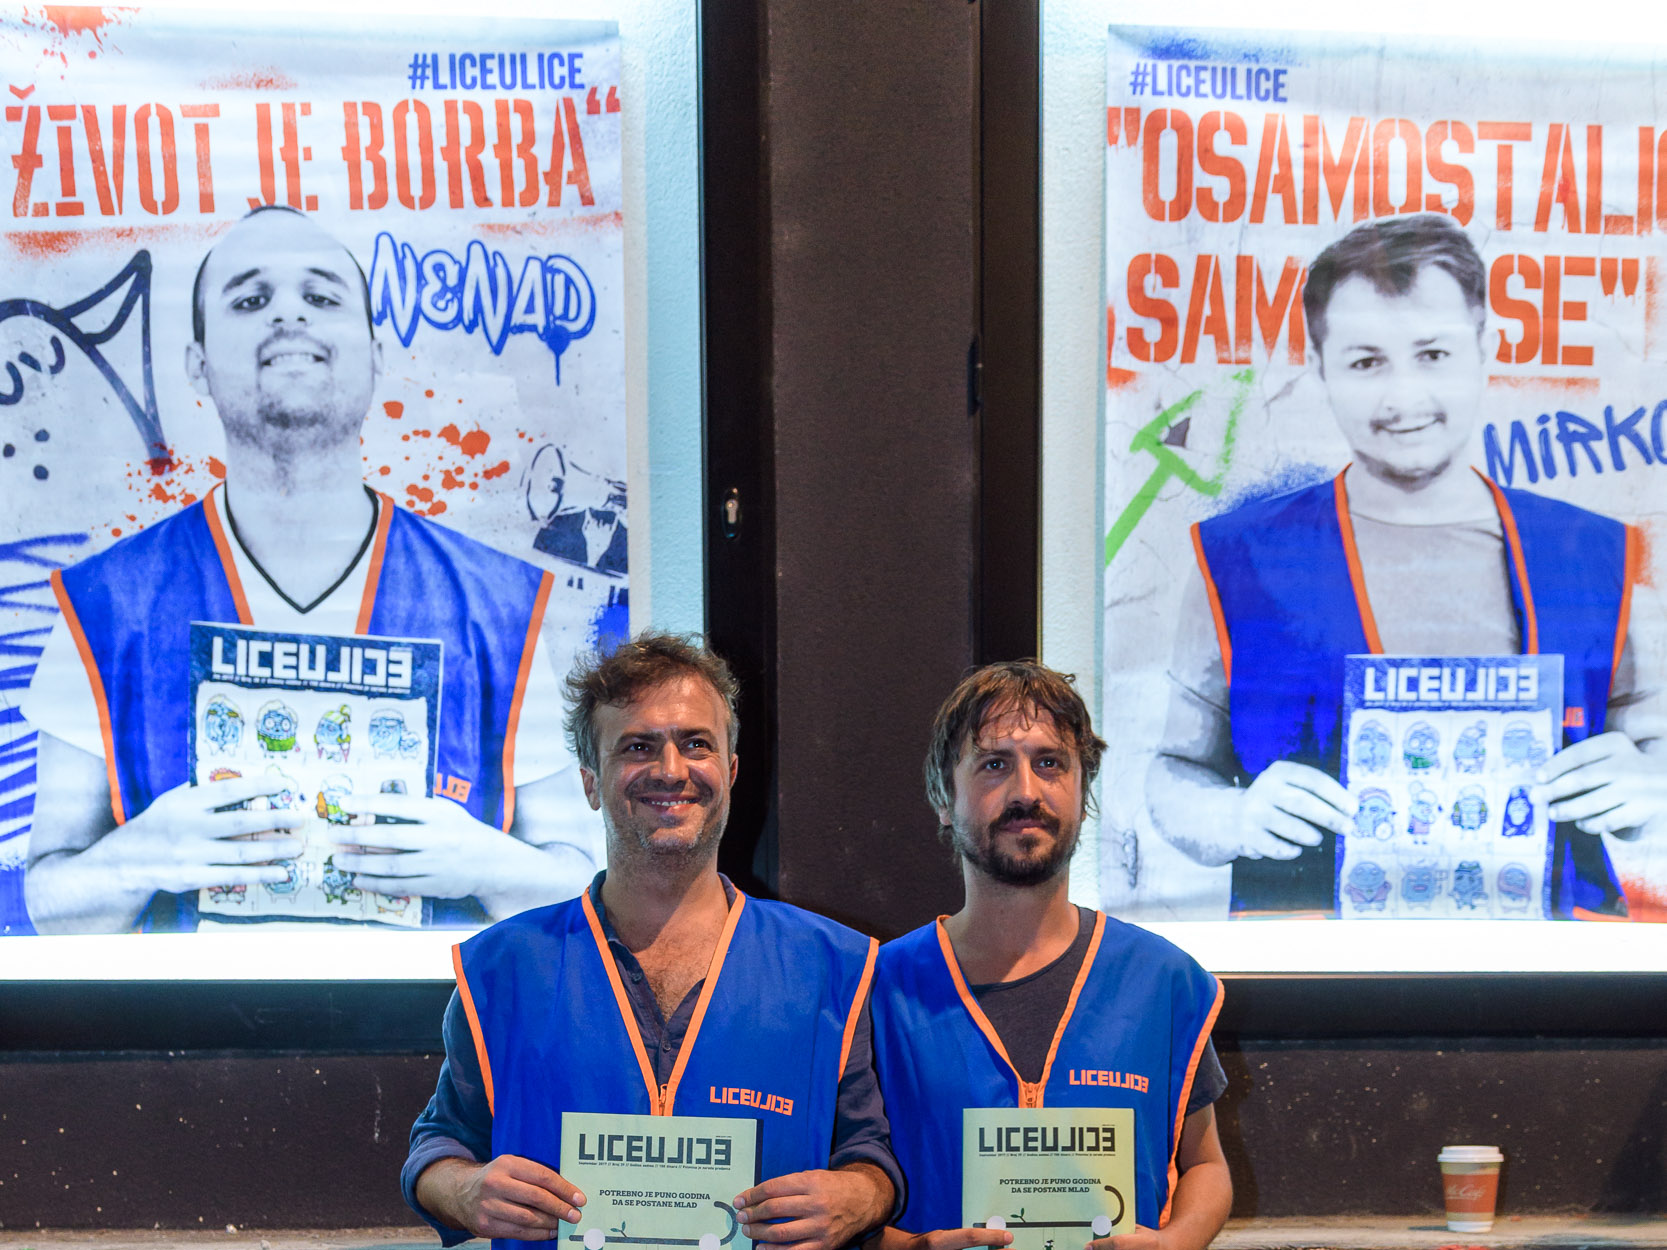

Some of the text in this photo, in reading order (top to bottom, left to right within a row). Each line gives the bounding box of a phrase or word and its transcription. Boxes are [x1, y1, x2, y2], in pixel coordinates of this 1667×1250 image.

[408, 52, 586, 91] #LICEULICE
[1129, 62, 1289, 103] #LICEULICE
[5, 84, 221, 218] ŽIVOT
[247, 100, 319, 212] JE
[1107, 106, 1667, 237] "OSAMOSTALI
[1126, 253, 1306, 367] SAM
[599, 1189, 644, 1198] POTREBNO
[654, 1191, 678, 1199] PUNO
[678, 1192, 711, 1200] GODINA
[624, 1199, 635, 1207] SE
[635, 1200, 673, 1208] POSTANE
[674, 1201, 698, 1209] MLAD
